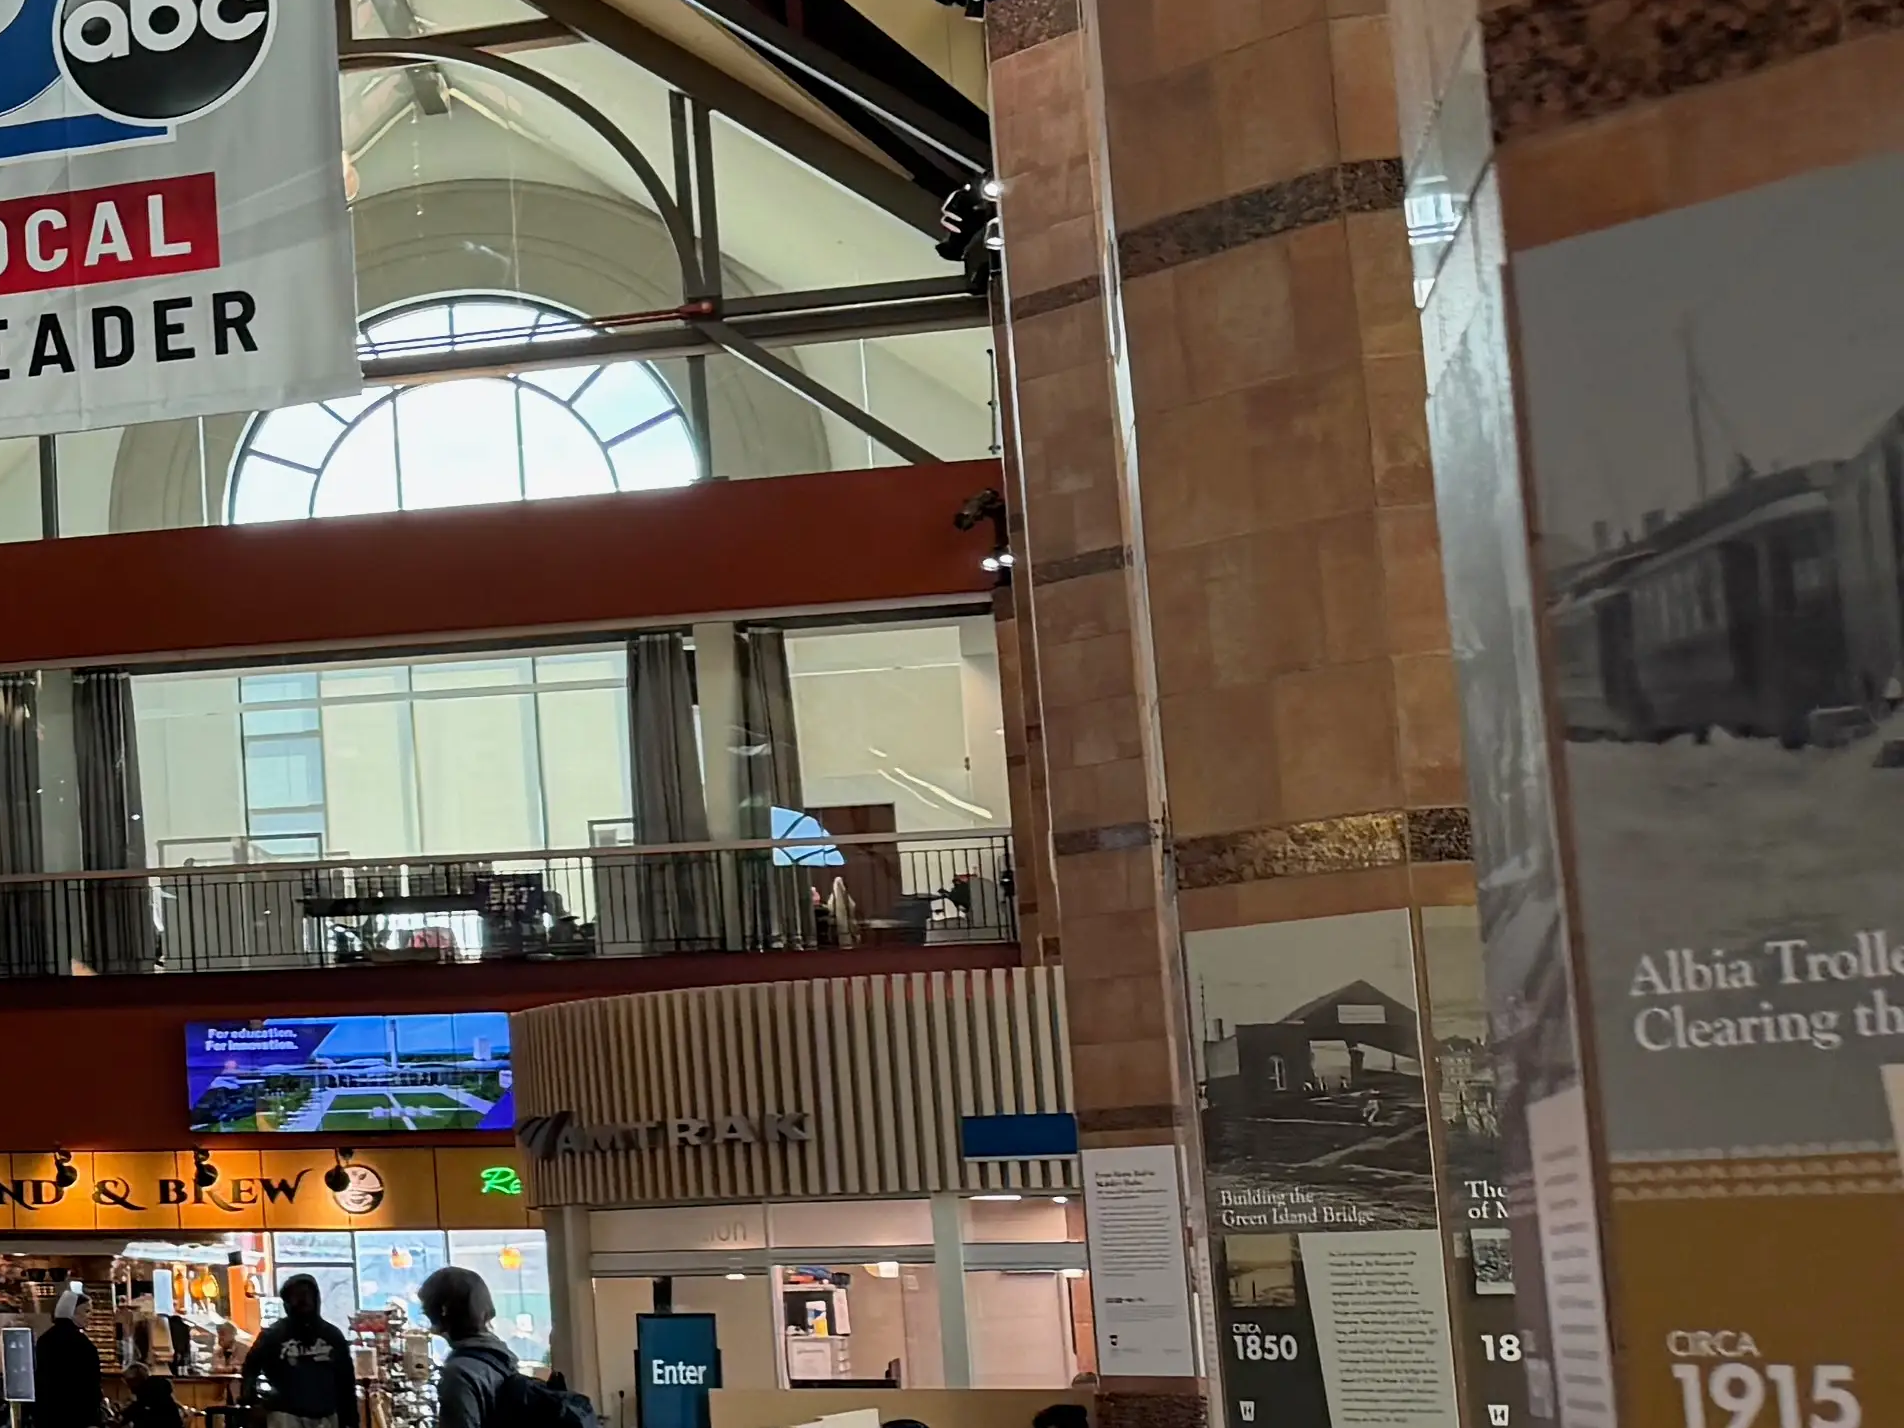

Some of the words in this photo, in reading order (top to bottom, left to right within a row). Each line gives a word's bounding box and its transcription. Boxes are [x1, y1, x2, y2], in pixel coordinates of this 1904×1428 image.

[1627, 947, 1755, 999] Albia
[207, 1028, 228, 1040] For
[229, 1027, 298, 1040] education.
[1632, 999, 1843, 1052] Clearing
[205, 1040, 227, 1052] For
[556, 1112, 813, 1154] AMTRAK
[91, 1175, 147, 1213] &
[158, 1166, 315, 1214] BREW
[1220, 1188, 1286, 1208] Building
[1292, 1186, 1314, 1204] the
[1221, 1209, 1267, 1227] Green
[1271, 1207, 1318, 1225] Island
[1323, 1205, 1376, 1225] Bridge
[1467, 1205, 1488, 1221] of
[1232, 1334, 1299, 1362] 1850
[1665, 1329, 1763, 1360] CIRCA
[651, 1358, 706, 1386] Enter
